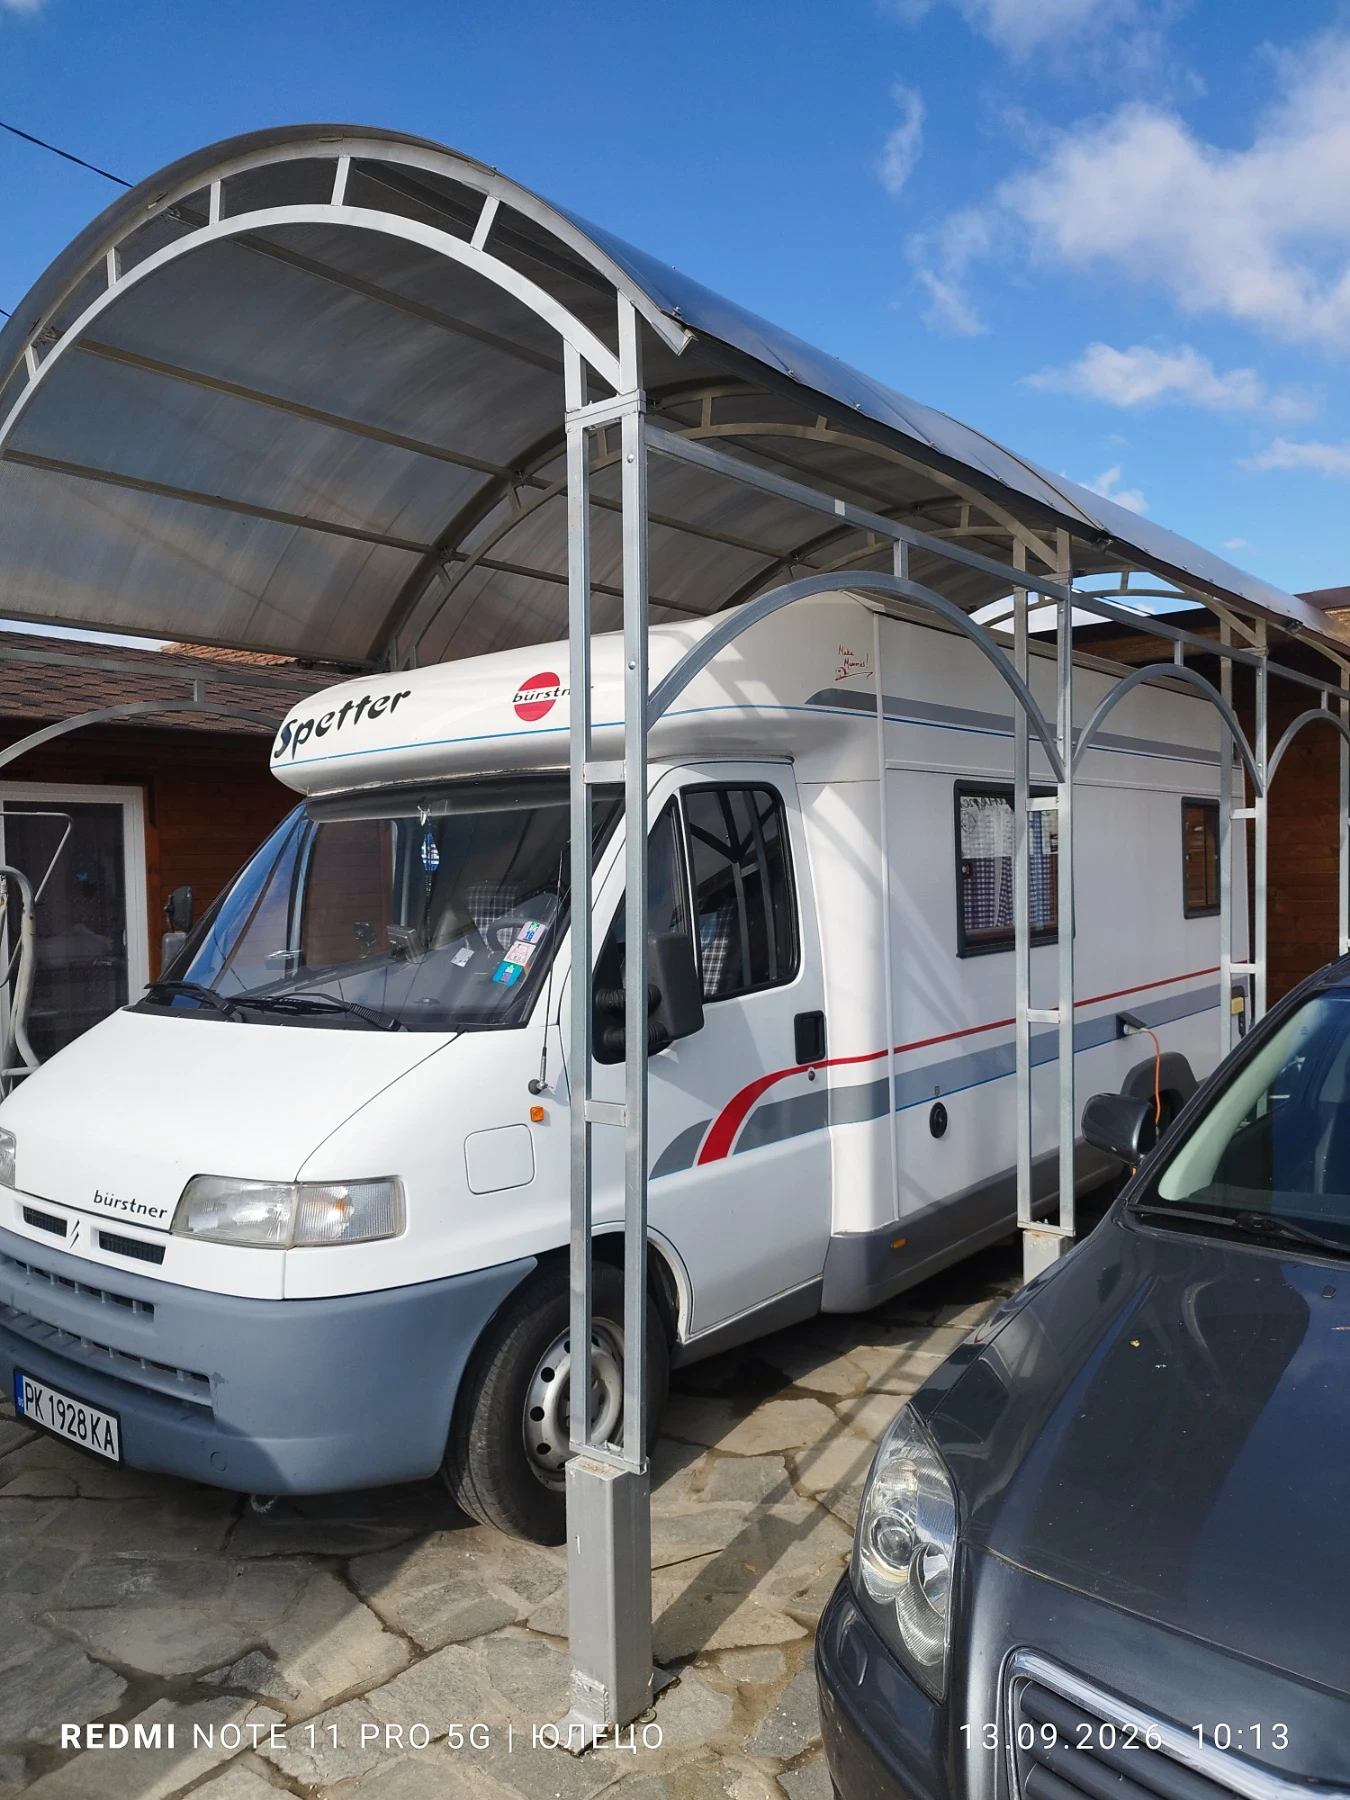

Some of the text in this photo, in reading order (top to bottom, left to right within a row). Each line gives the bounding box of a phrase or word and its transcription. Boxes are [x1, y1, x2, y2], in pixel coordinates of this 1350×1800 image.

[512, 685, 595, 704] bürstn
[273, 690, 412, 761] Spetter
[93, 1189, 168, 1219] bürstner
[24, 1381, 115, 1455] PK 1928 KA
